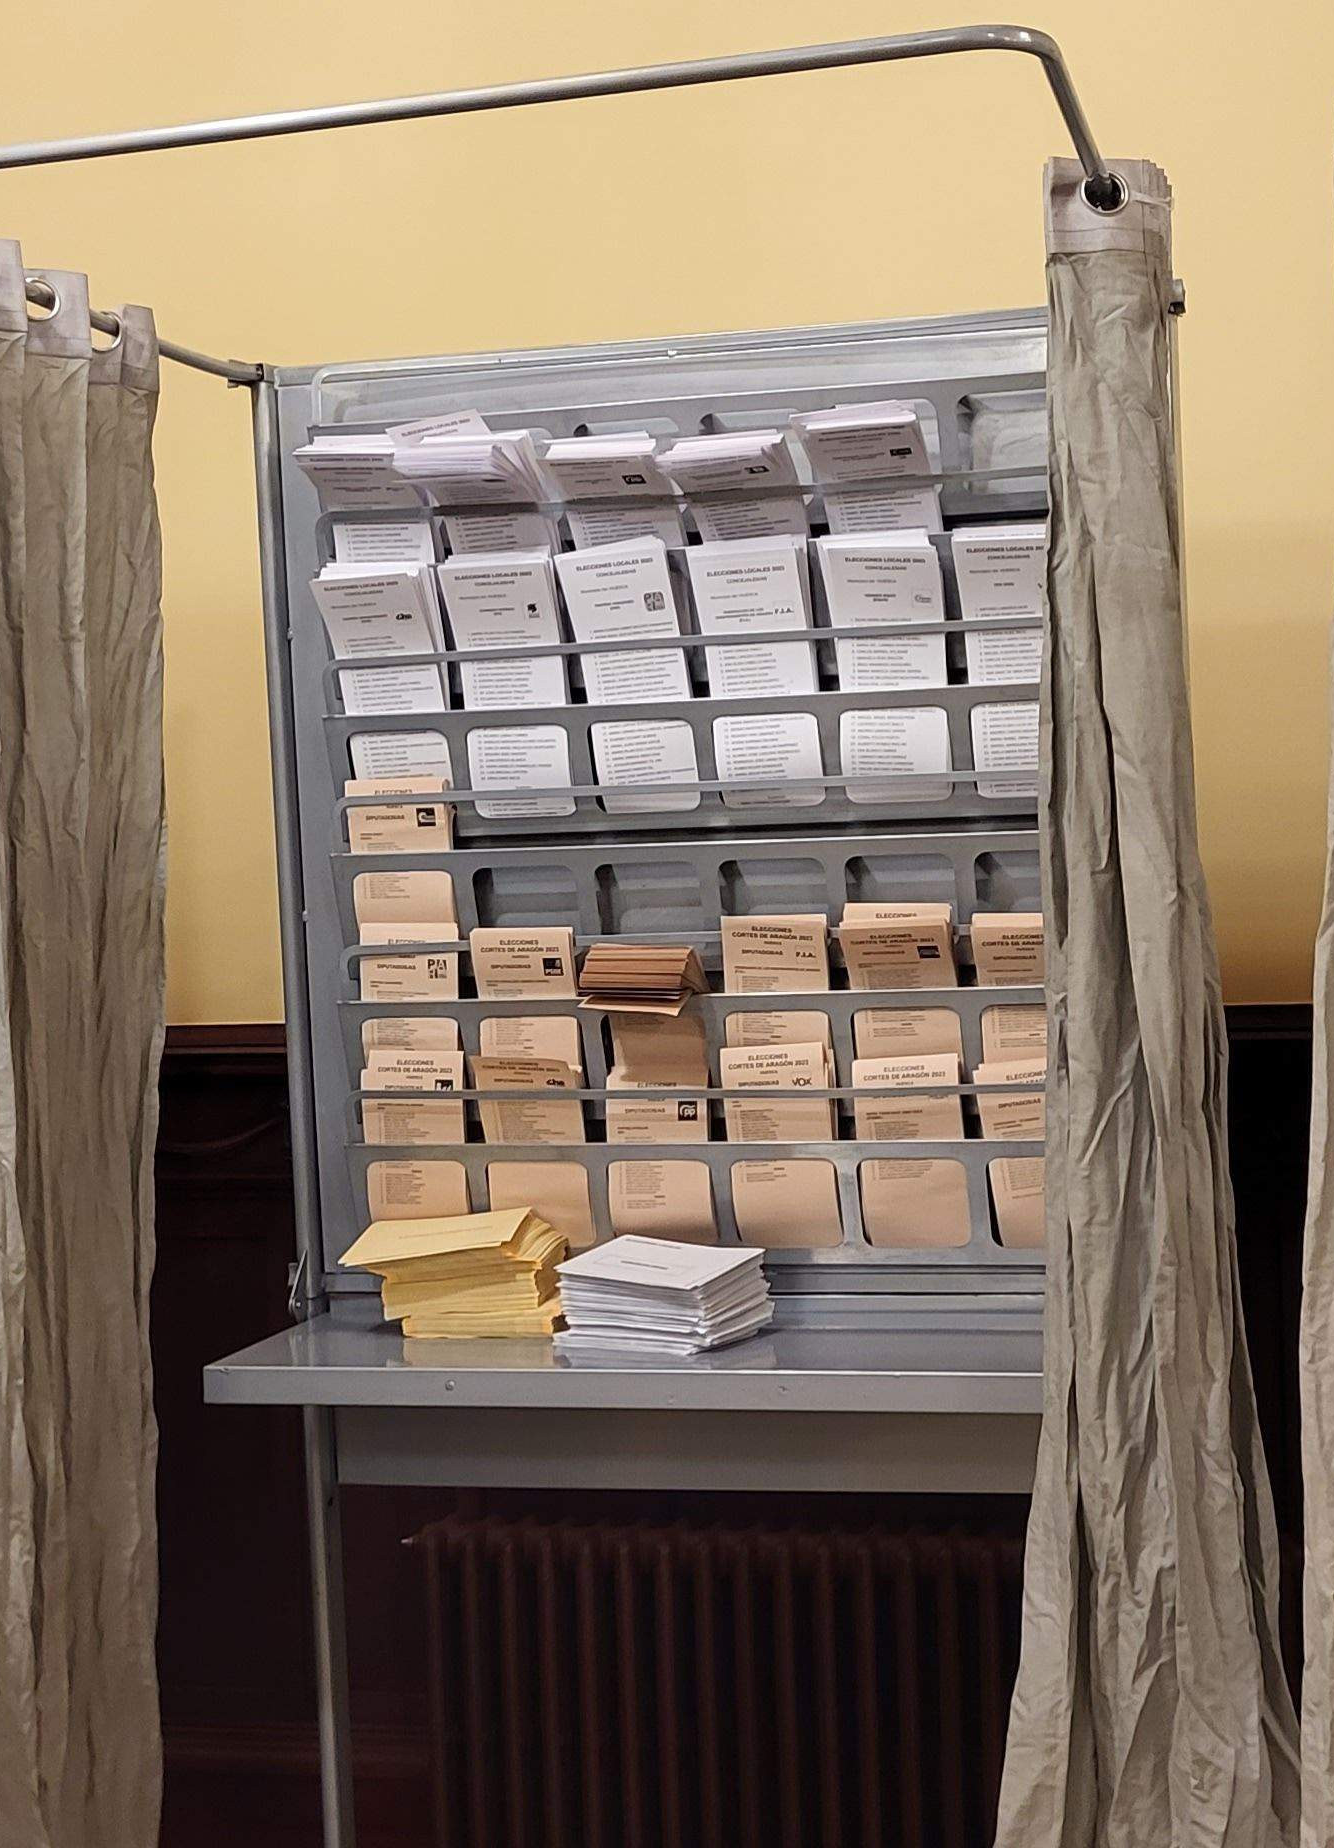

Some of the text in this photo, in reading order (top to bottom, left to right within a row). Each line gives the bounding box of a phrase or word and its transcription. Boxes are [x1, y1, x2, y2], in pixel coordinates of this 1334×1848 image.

[575, 562, 612, 571] ELECCIONES
[613, 558, 639, 566] LOCALES
[707, 568, 743, 577] ELECCIONES
[744, 566, 771, 574] LOCALES
[747, 1053, 789, 1061] ELECCIONES
[728, 1062, 755, 1070] CORTES
[883, 1064, 925, 1072] ELECCIONES
[863, 1073, 890, 1081] CORTES
[891, 1072, 899, 1080] DE
[792, 1077, 812, 1086] VOX
